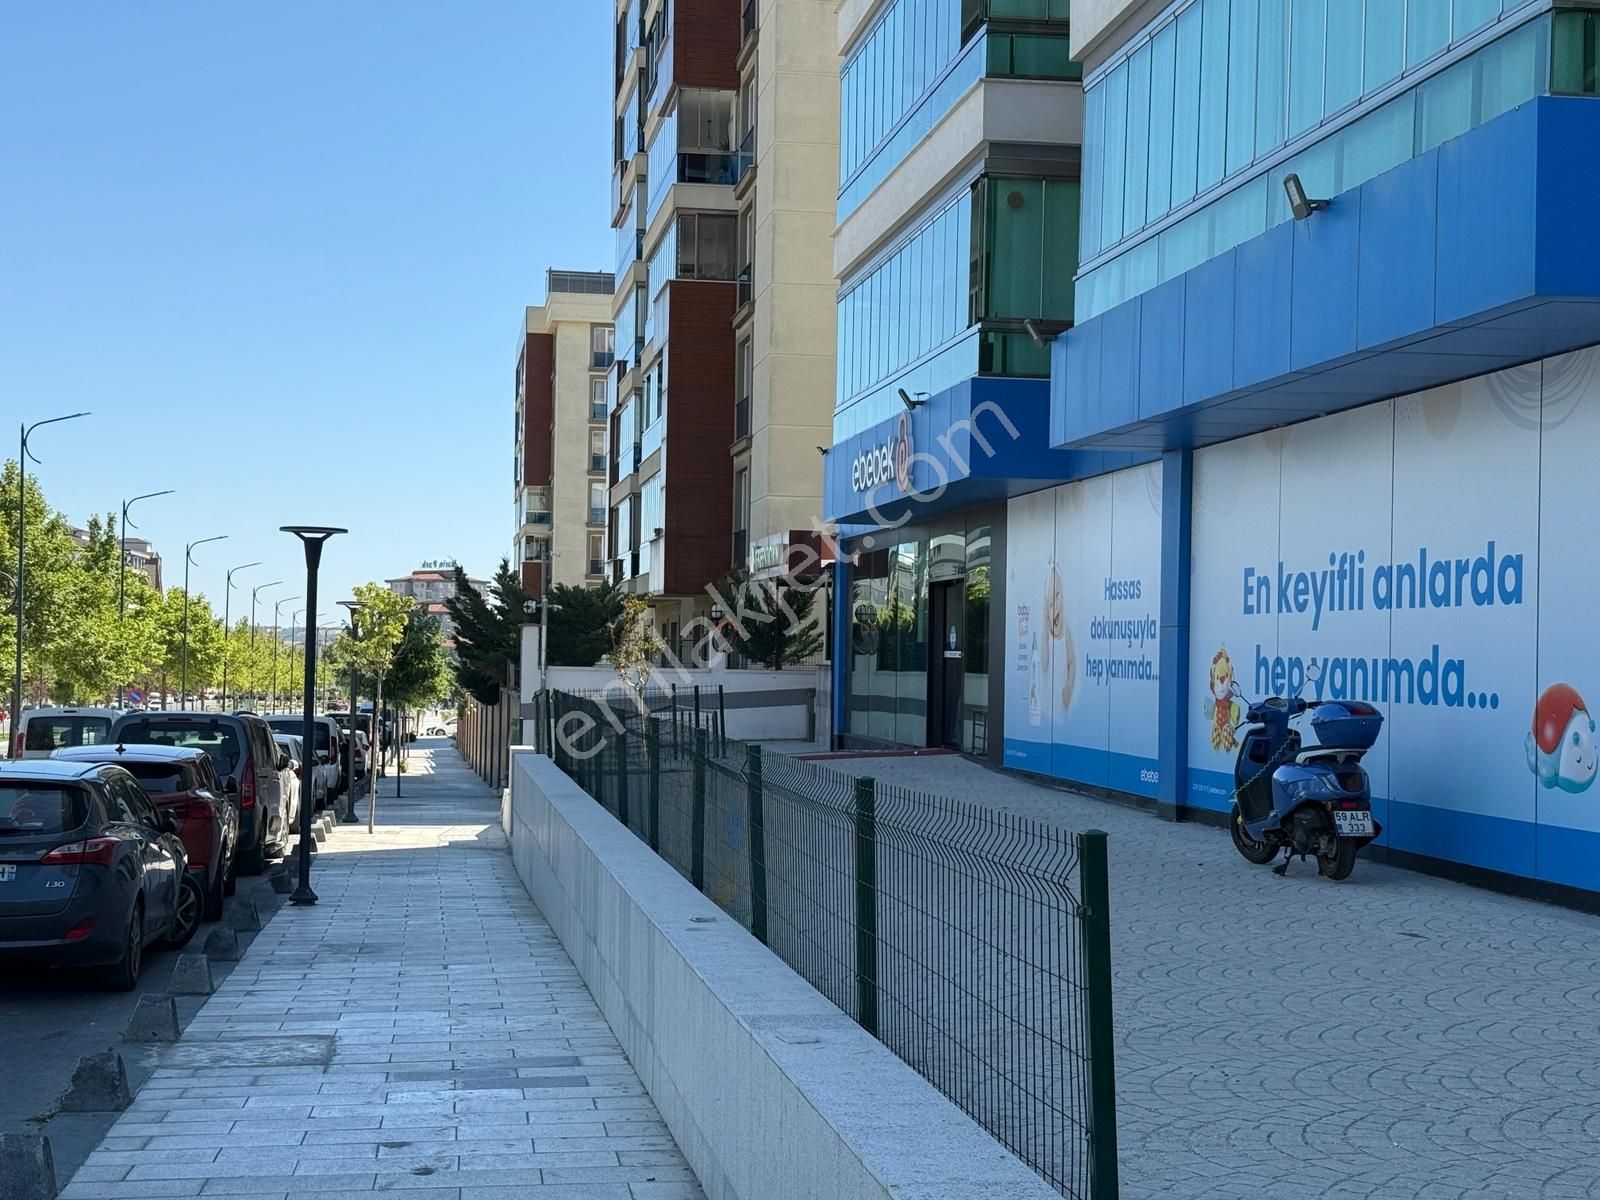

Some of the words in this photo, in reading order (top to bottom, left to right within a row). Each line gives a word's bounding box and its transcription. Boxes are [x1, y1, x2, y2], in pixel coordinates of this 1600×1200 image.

[852, 435, 895, 493] ebebek
[1104, 577, 1142, 601] Hassas
[1243, 567, 1271, 615] En
[1278, 549, 1365, 632] keyifli
[1372, 540, 1524, 610] anlarda
[1090, 613, 1157, 649] dokunuşuyla
[1086, 653, 1104, 686] hep
[1255, 644, 1305, 700] hep
[1310, 644, 1500, 710] yanımda...
[1335, 812, 1348, 822] 59
[1350, 812, 1370, 822] ALR
[1347, 823, 1365, 832] 333
